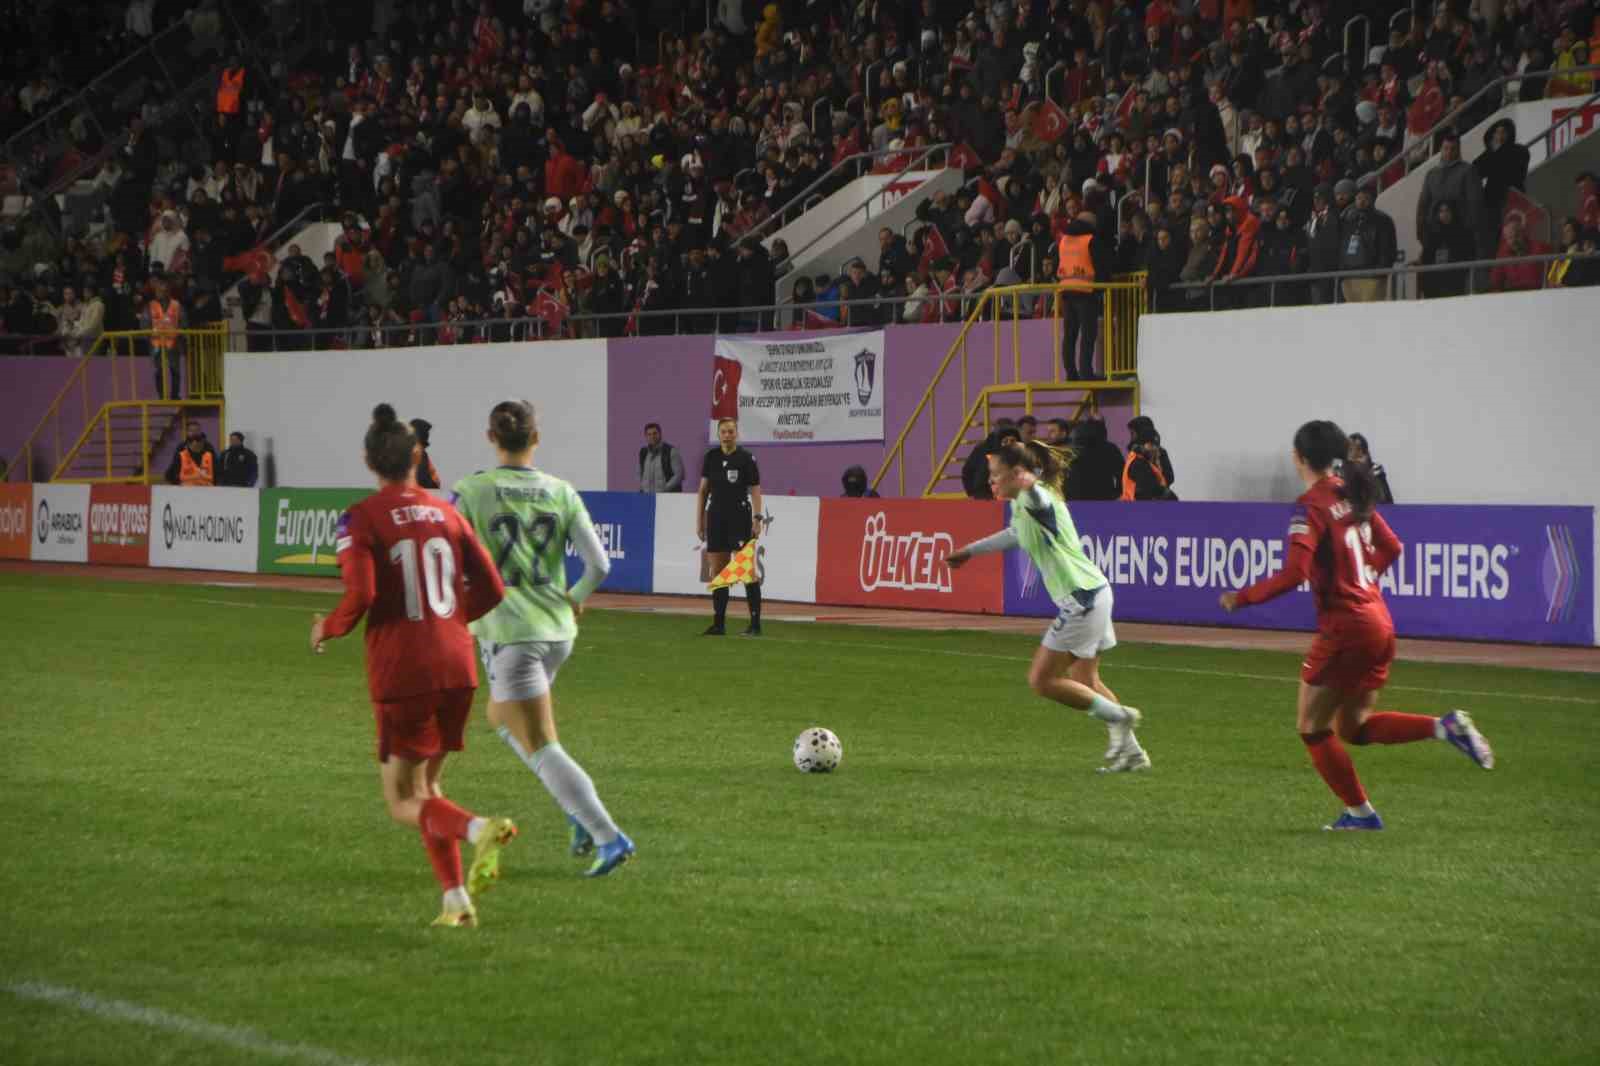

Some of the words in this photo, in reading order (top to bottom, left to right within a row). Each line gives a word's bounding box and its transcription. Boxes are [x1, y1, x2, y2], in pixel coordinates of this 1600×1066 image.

[51, 512, 82, 531] ARABICA
[174, 514, 197, 542] NATA
[198, 515, 244, 544] HOLDING
[490, 512, 560, 591] 22
[859, 511, 952, 592] ÜLKER
[389, 537, 457, 620] 10
[1081, 535, 1168, 587] OMEN'S
